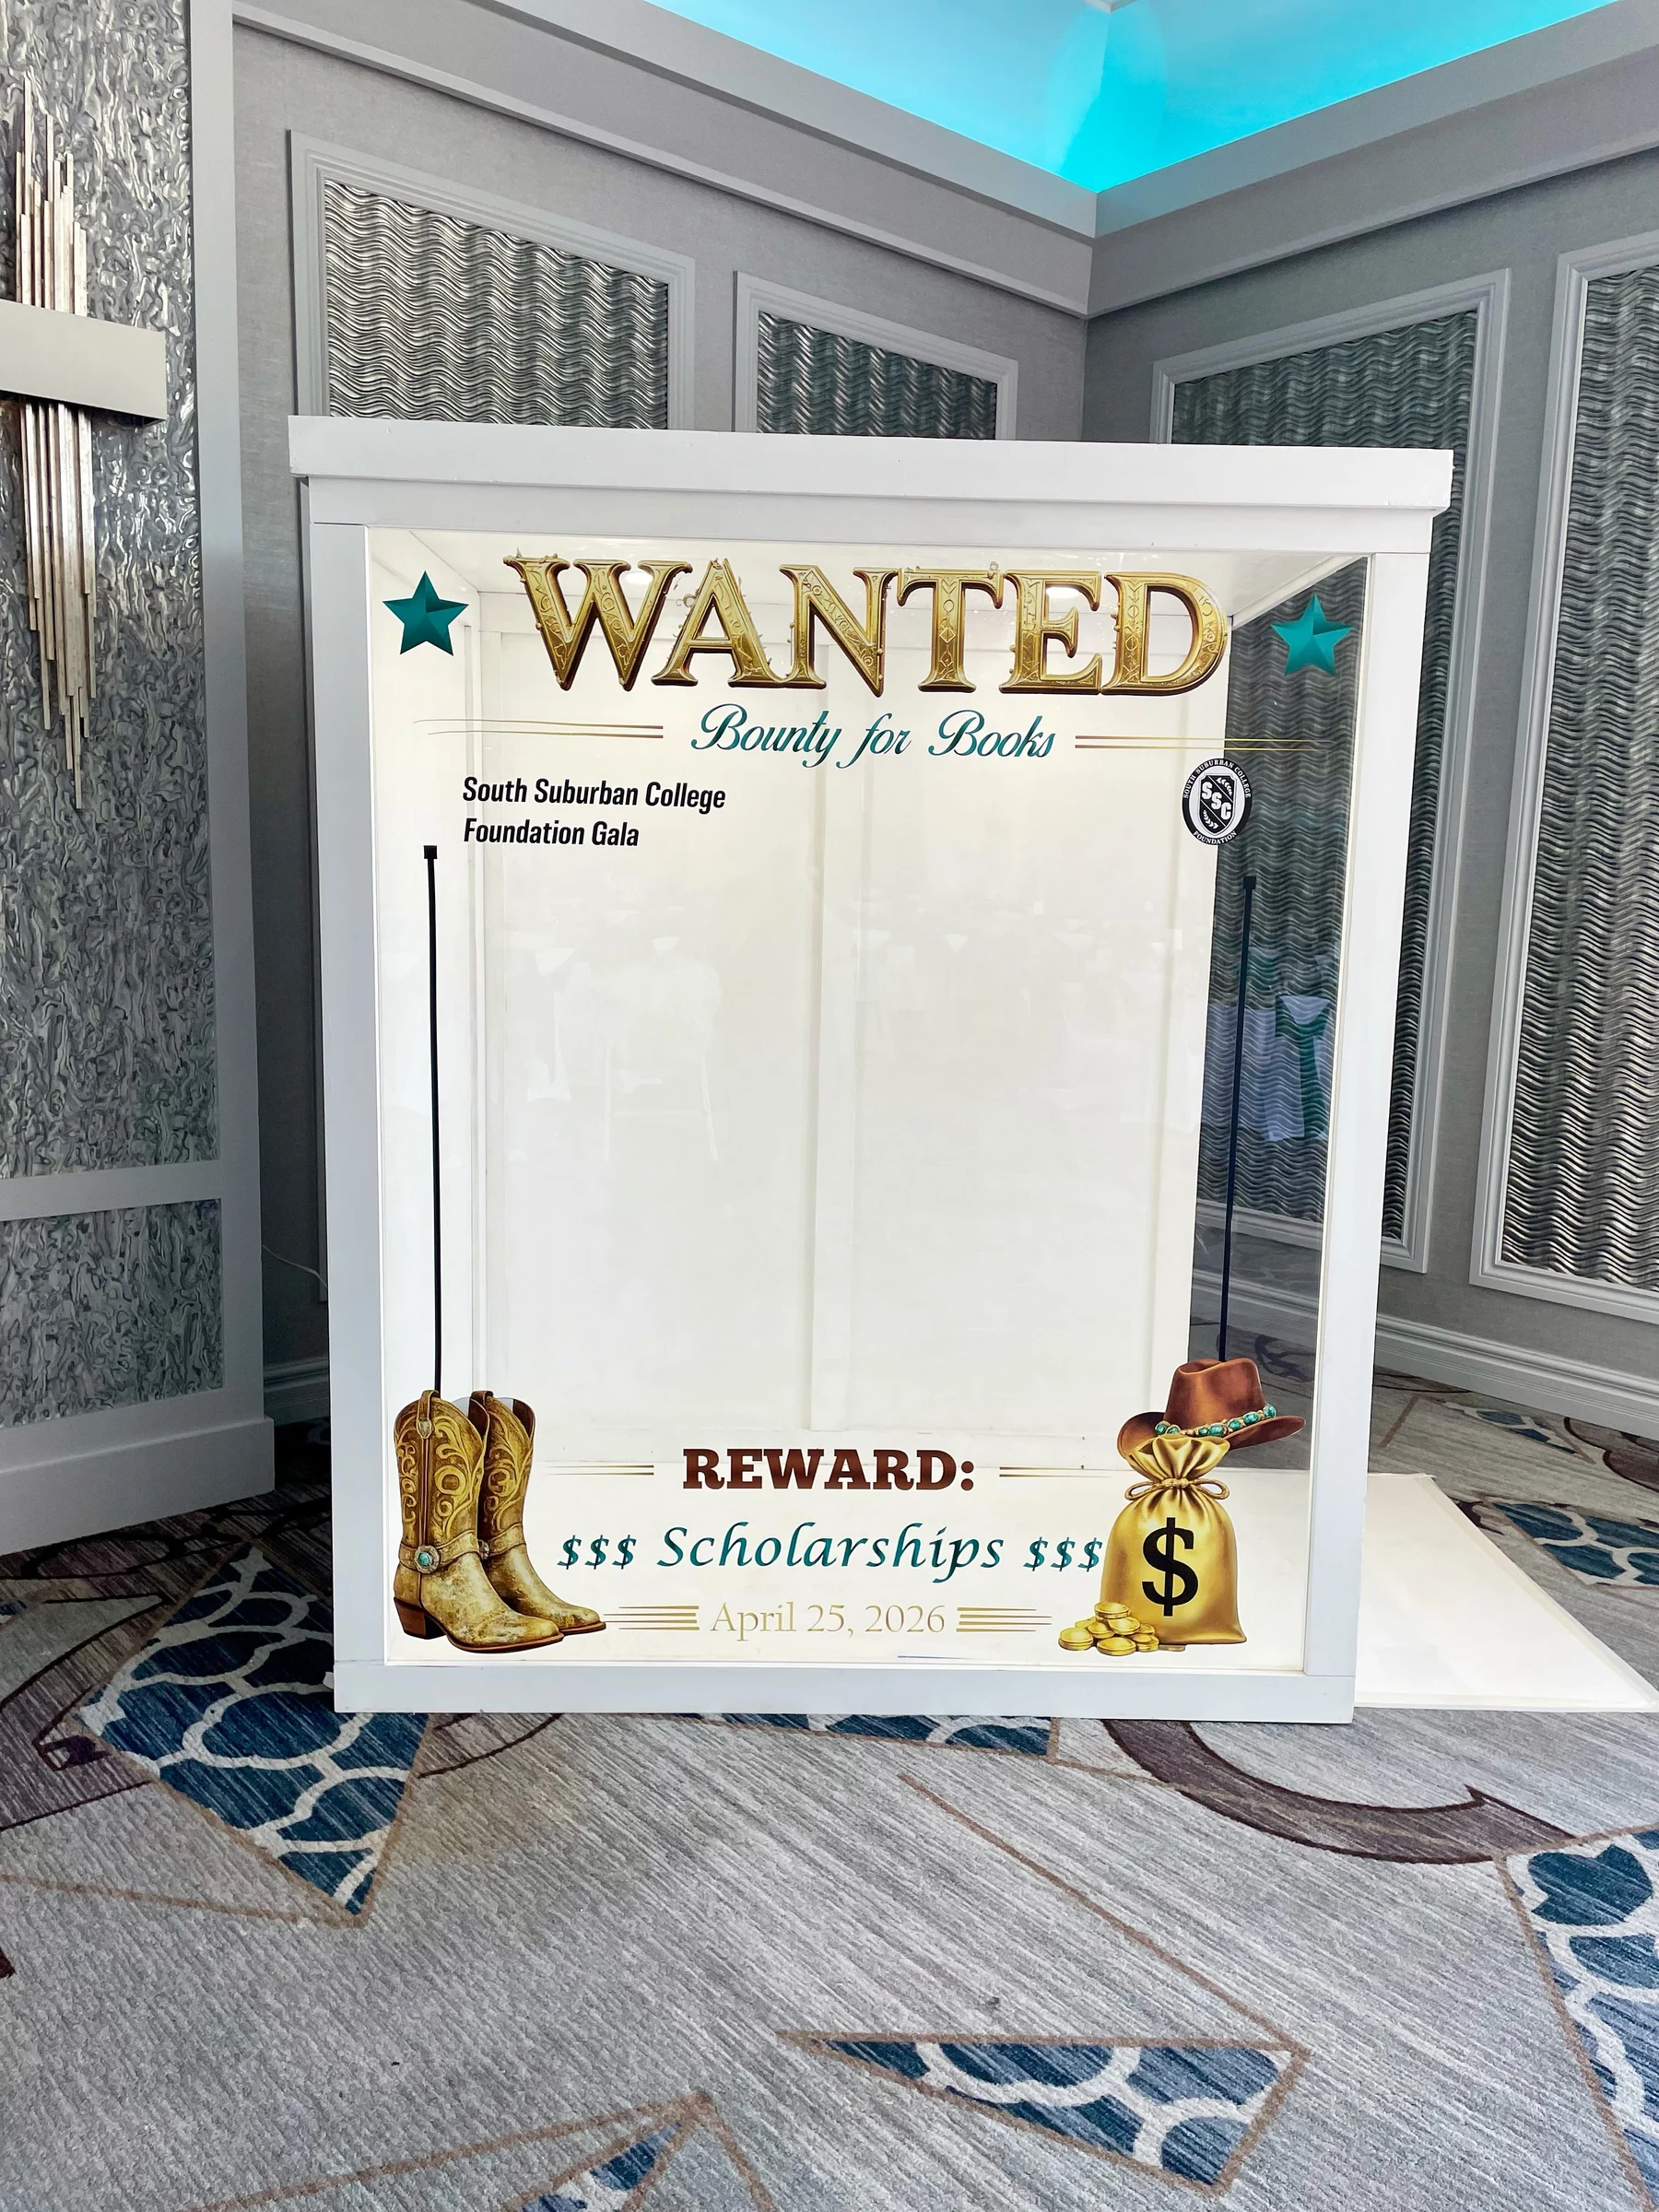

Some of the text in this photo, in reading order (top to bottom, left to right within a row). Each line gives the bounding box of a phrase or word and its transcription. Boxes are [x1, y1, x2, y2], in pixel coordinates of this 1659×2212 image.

[503, 548, 1228, 696] WANTED
[690, 703, 1056, 769] Bounty for Books
[462, 777, 725, 815] South Suburban College
[1183, 759, 1252, 798] SOUTH SUBURBAN COLLEGE
[1201, 782, 1231, 820] SSC
[464, 818, 640, 847] Foundation Gala
[1193, 830, 1237, 844] FOUNDATION
[683, 1448, 974, 1491] REWARD:
[558, 1522, 1102, 1583] $$$ Scholarships $$$
[1141, 1517, 1198, 1617] $
[711, 1602, 946, 1641] April 25, 2026
